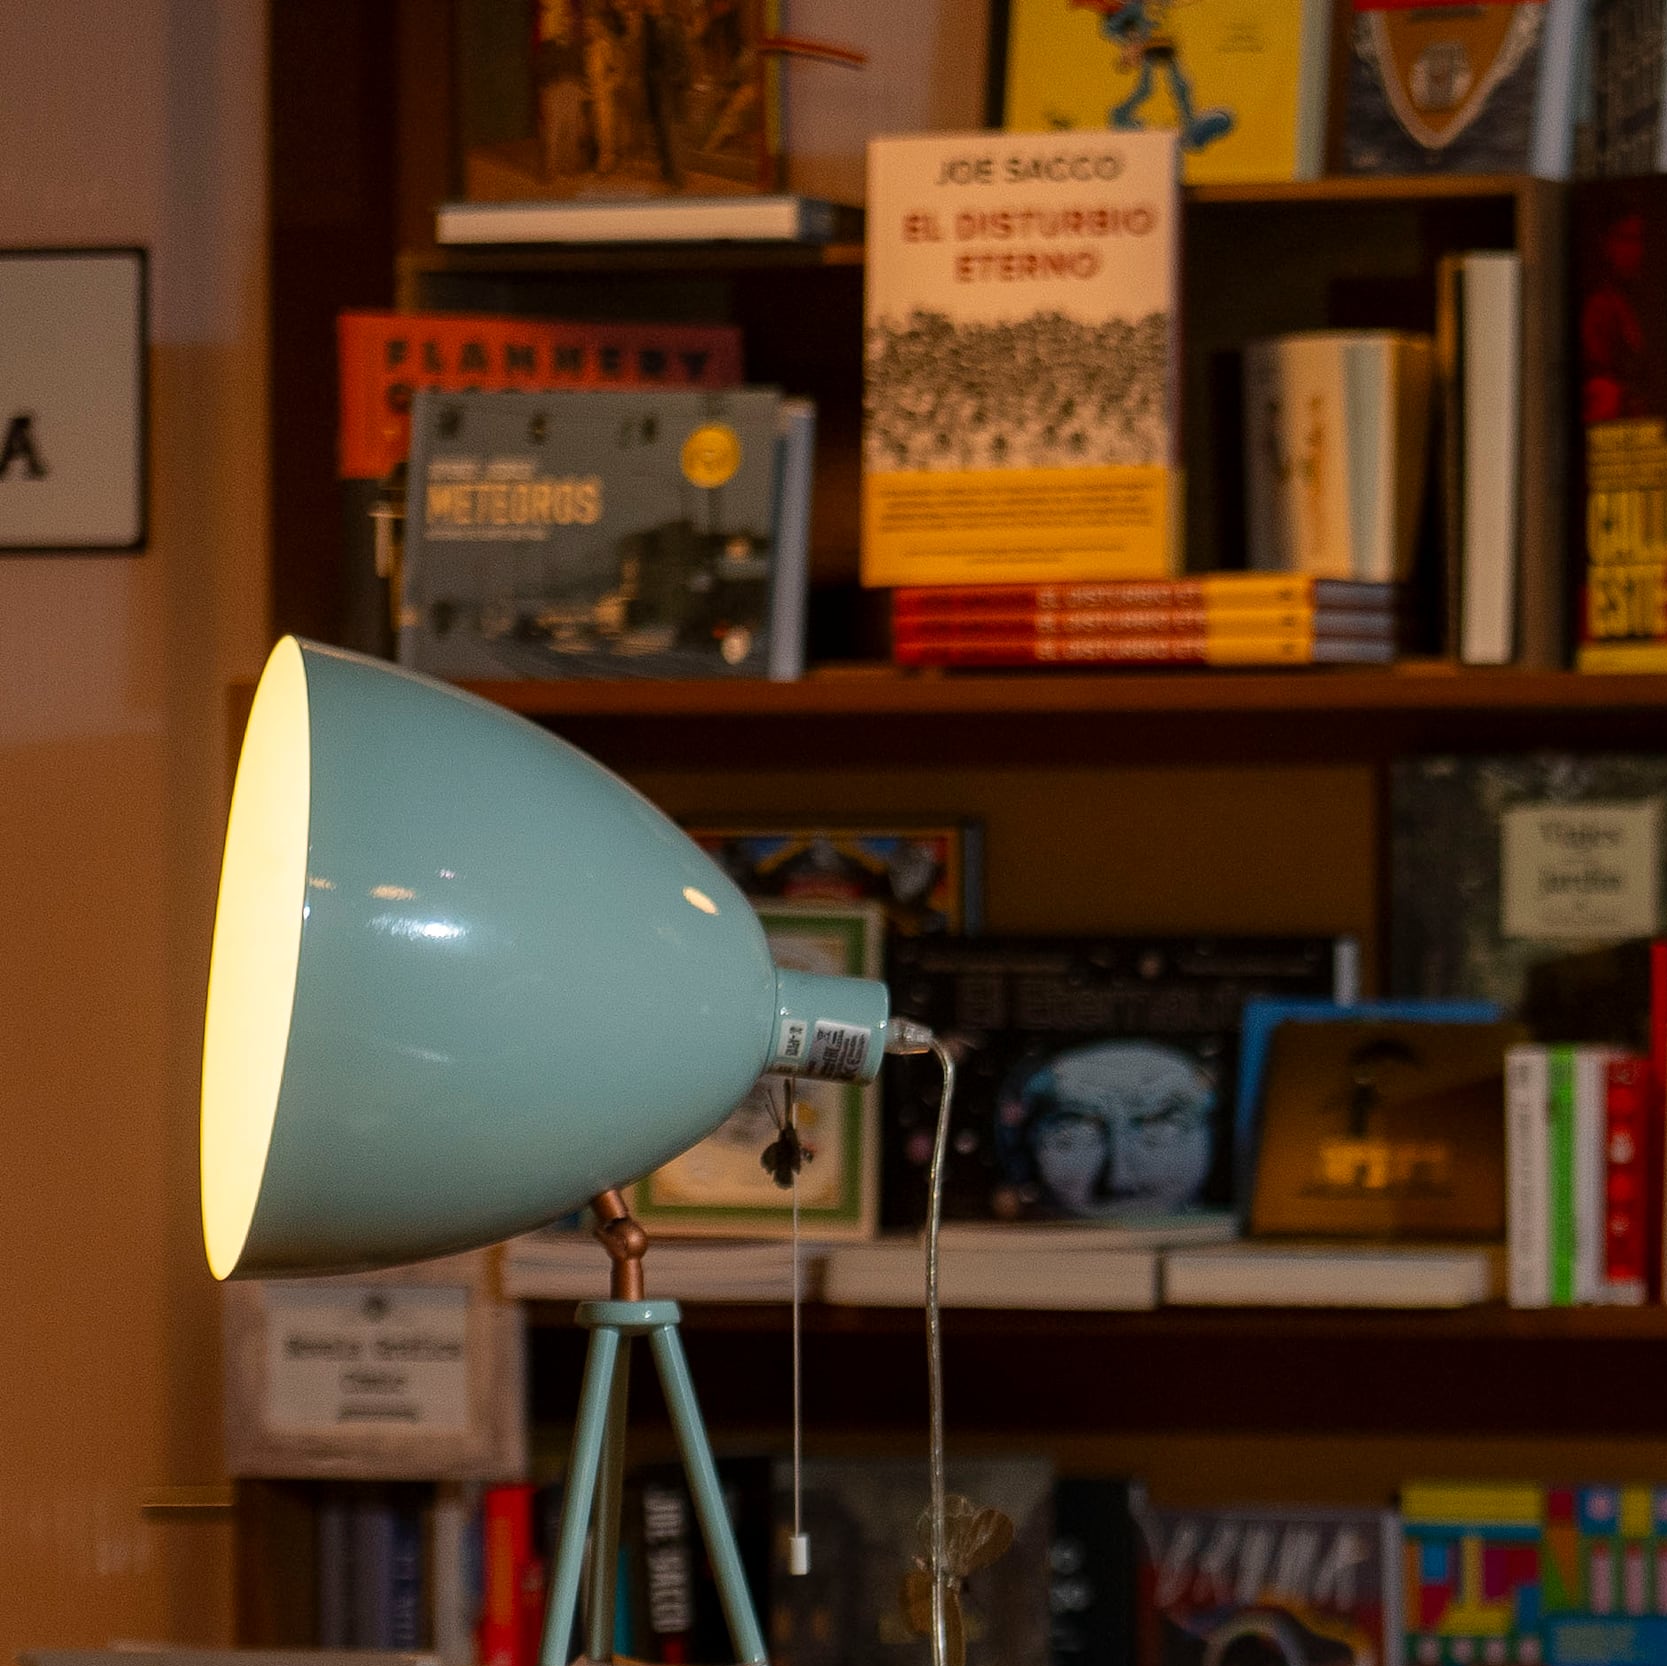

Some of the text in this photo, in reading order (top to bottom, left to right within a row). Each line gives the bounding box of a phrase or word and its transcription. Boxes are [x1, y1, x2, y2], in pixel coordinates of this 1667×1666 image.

[934, 153, 1126, 187] JOE SACCO
[903, 206, 1158, 245] EL DISTURBIO
[954, 250, 1099, 285] ETERNO
[426, 477, 602, 526] METEOROS
